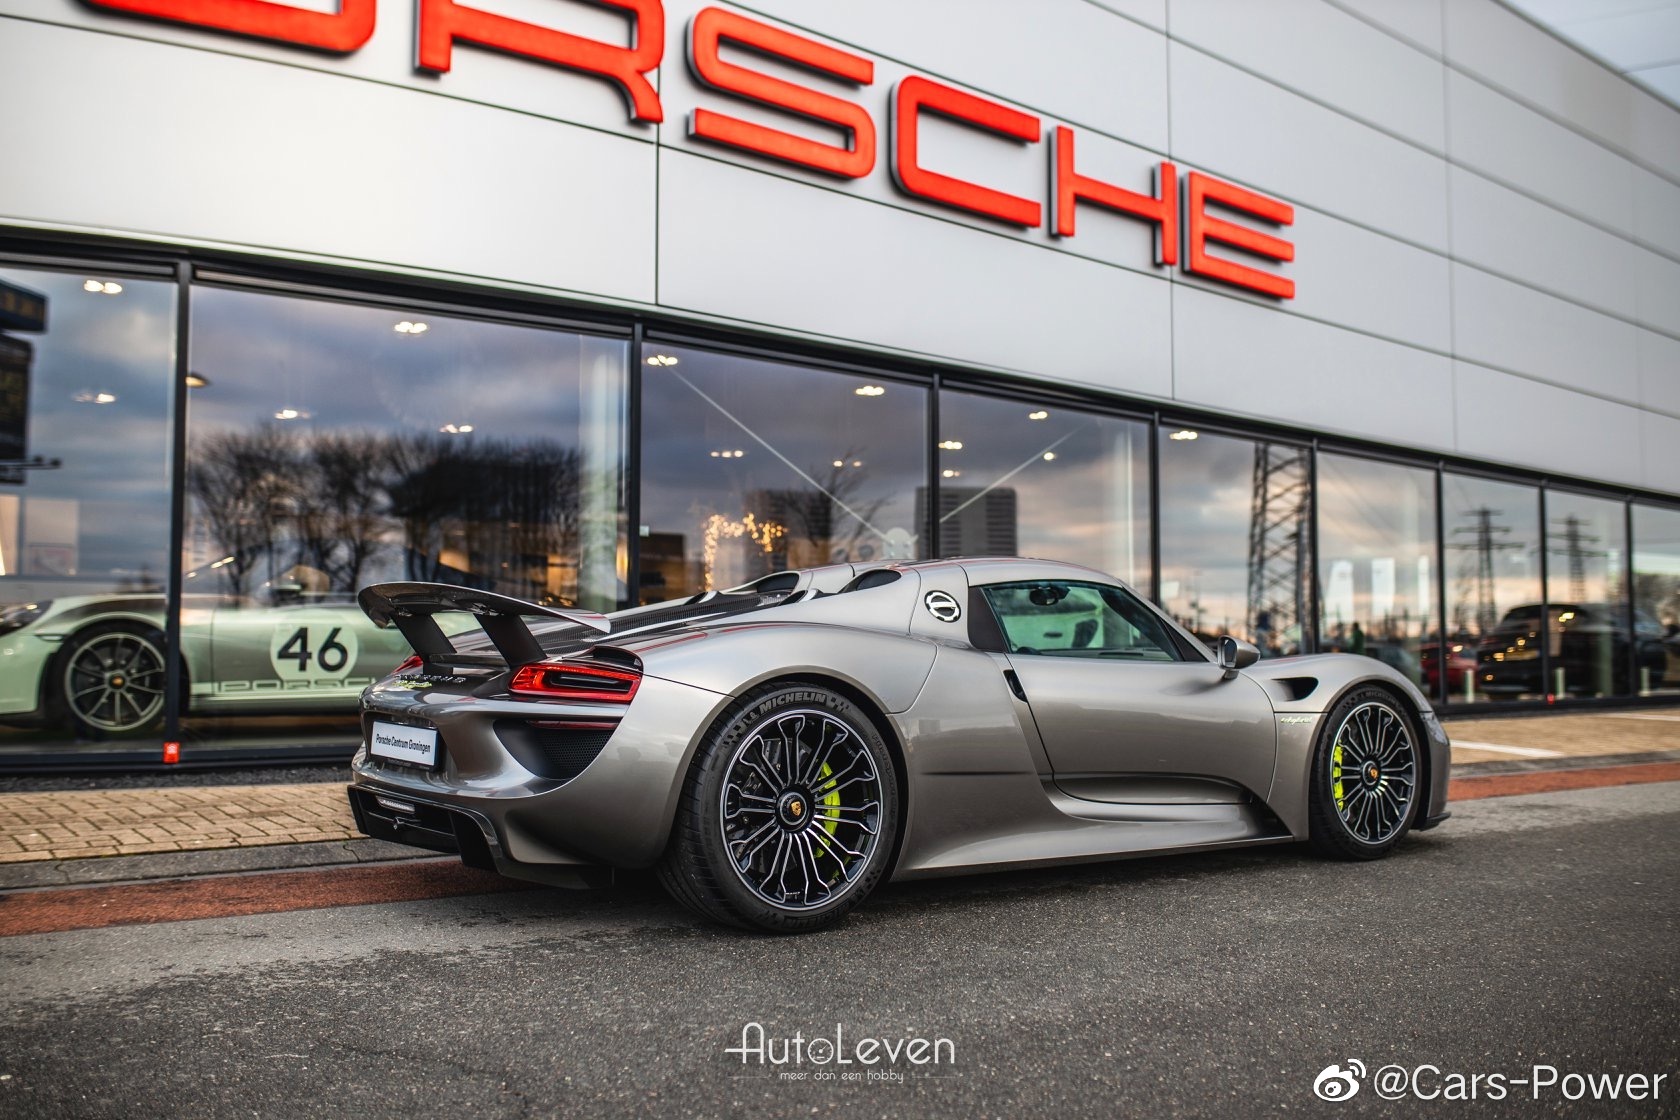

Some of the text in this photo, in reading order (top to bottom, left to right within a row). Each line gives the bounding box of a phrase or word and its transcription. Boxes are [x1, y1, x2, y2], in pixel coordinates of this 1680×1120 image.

[277, 627, 348, 672] 46
[759, 691, 827, 714] MICHELIN
[376, 733, 431, 755] Porsche Centrum Groningen
